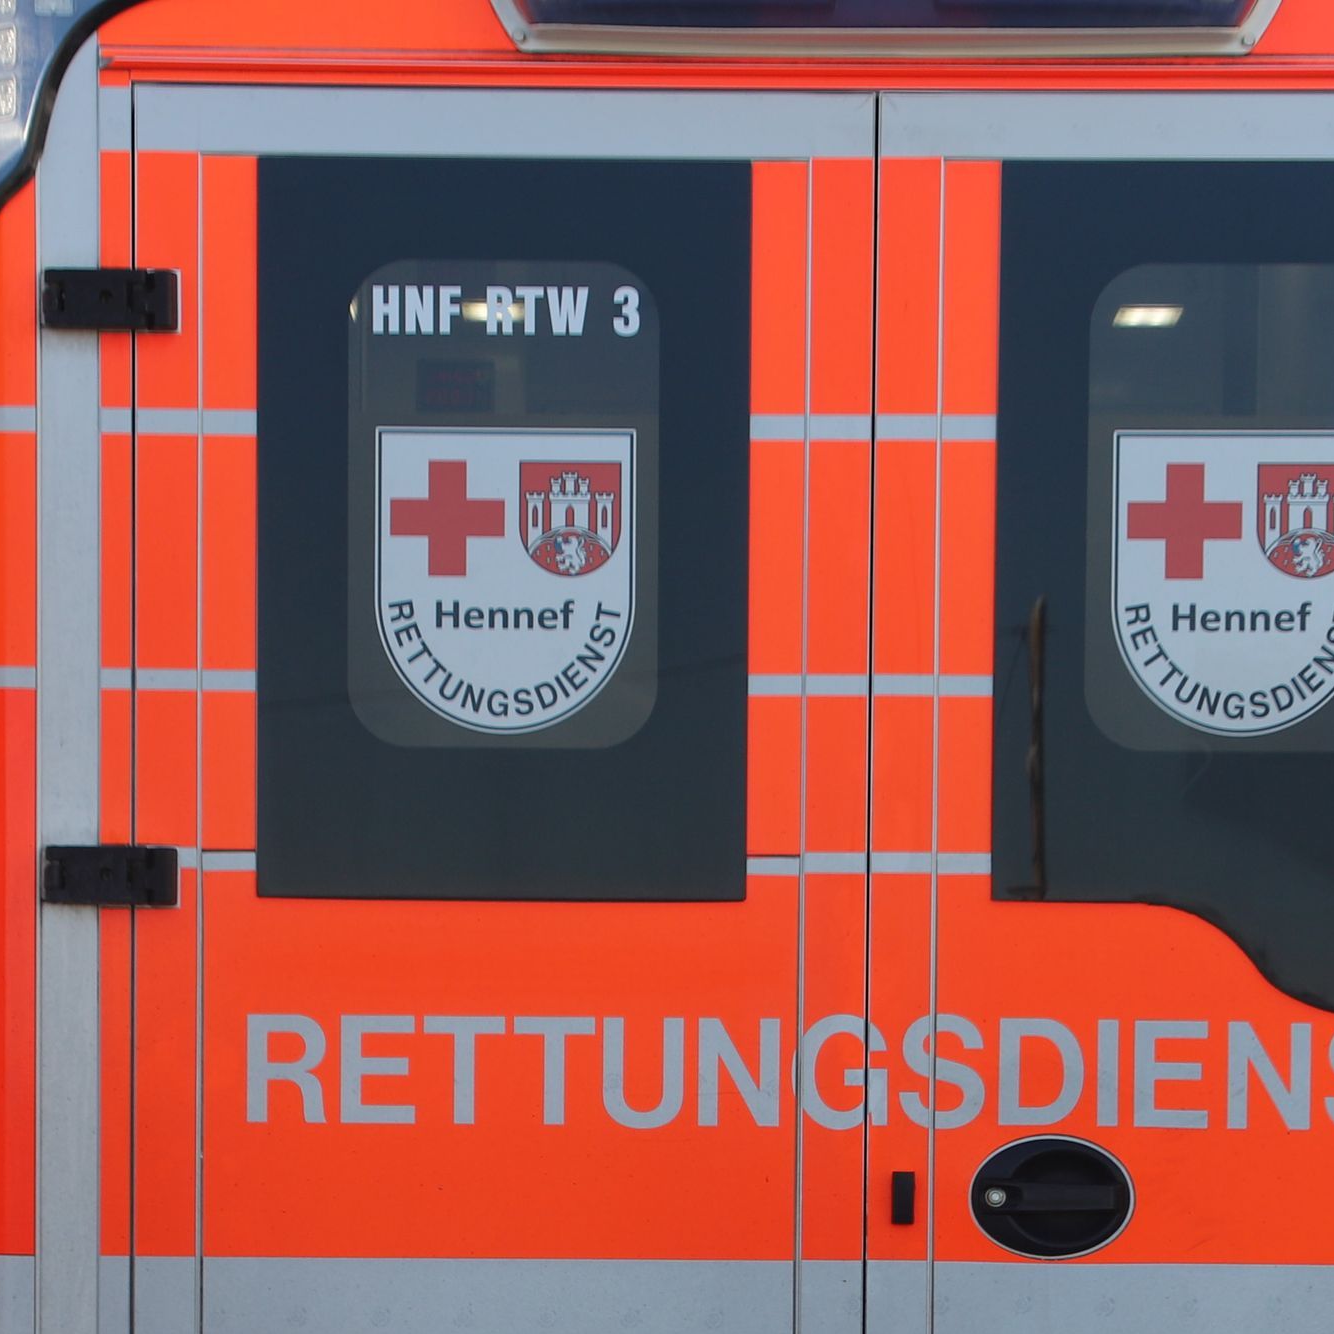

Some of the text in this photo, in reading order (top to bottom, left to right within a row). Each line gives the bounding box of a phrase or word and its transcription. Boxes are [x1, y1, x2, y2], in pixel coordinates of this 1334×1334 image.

[372, 284, 640, 337] HNF RTW 3
[435, 599, 575, 630] Hennef
[1171, 601, 1312, 632] Hennef
[388, 599, 621, 717] RETTUNGSDIENST
